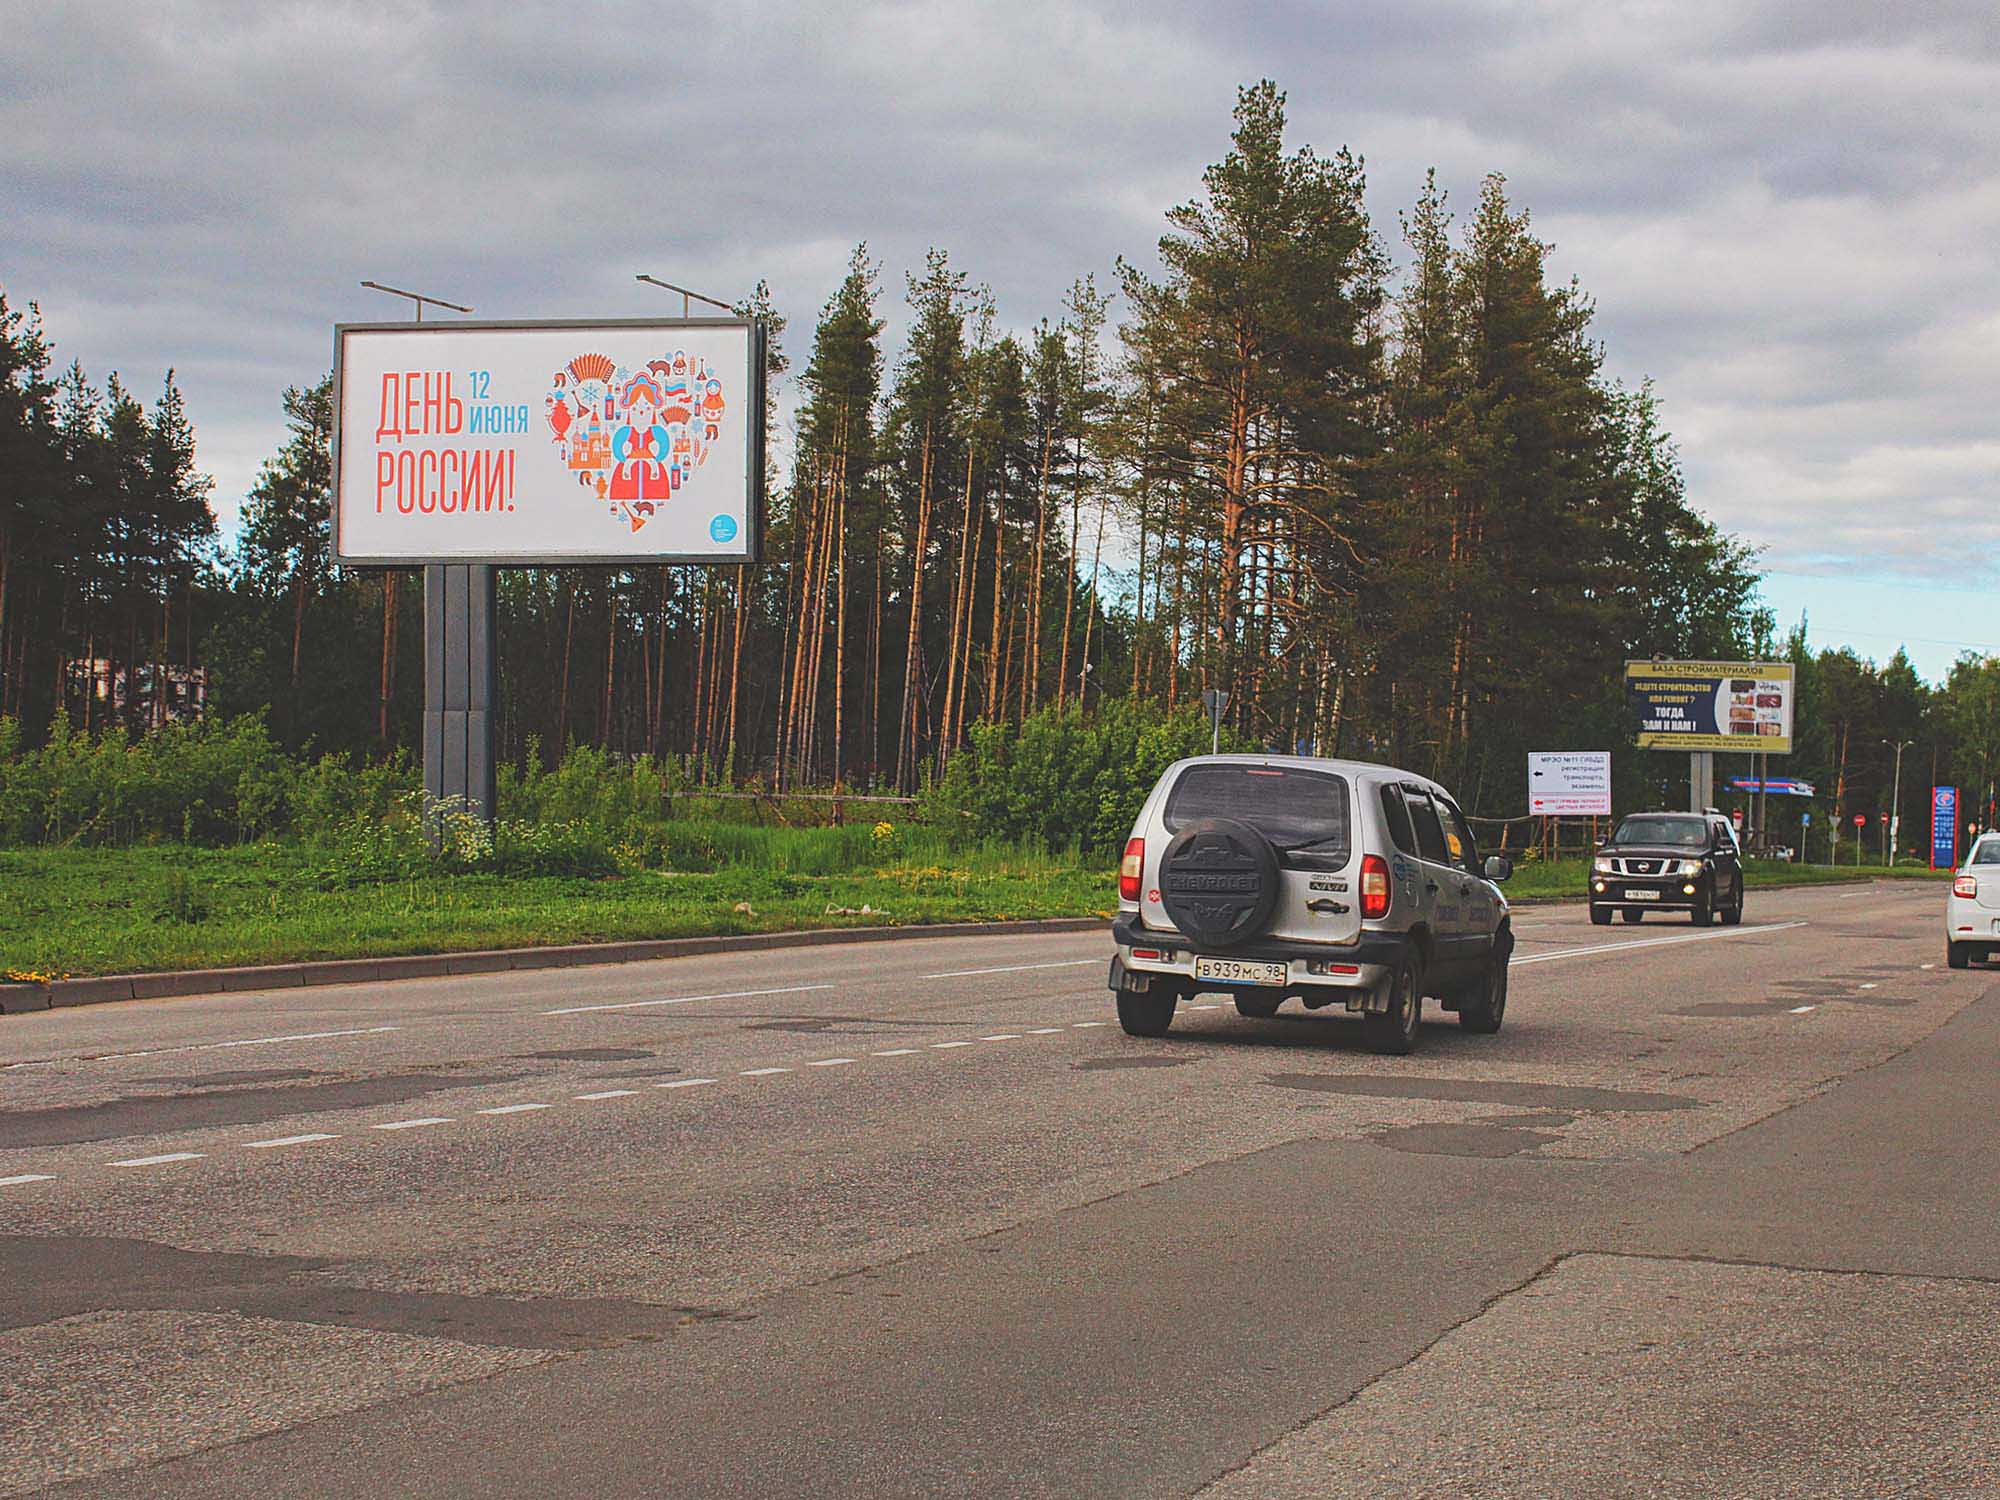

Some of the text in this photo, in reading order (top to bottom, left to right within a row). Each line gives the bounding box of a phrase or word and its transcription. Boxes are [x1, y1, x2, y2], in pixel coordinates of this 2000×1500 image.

[469, 370, 490, 399] 12
[376, 371, 463, 444] ДЕНЬ
[469, 405, 529, 434] ИЮНЯ
[376, 449, 515, 514] РОССИИ!
[1676, 664, 1764, 674] СТРОЙМАТЕРИАЛОВ
[1655, 707, 1684, 719] ТОГДА
[1168, 876, 1261, 889] CHEVROLET
